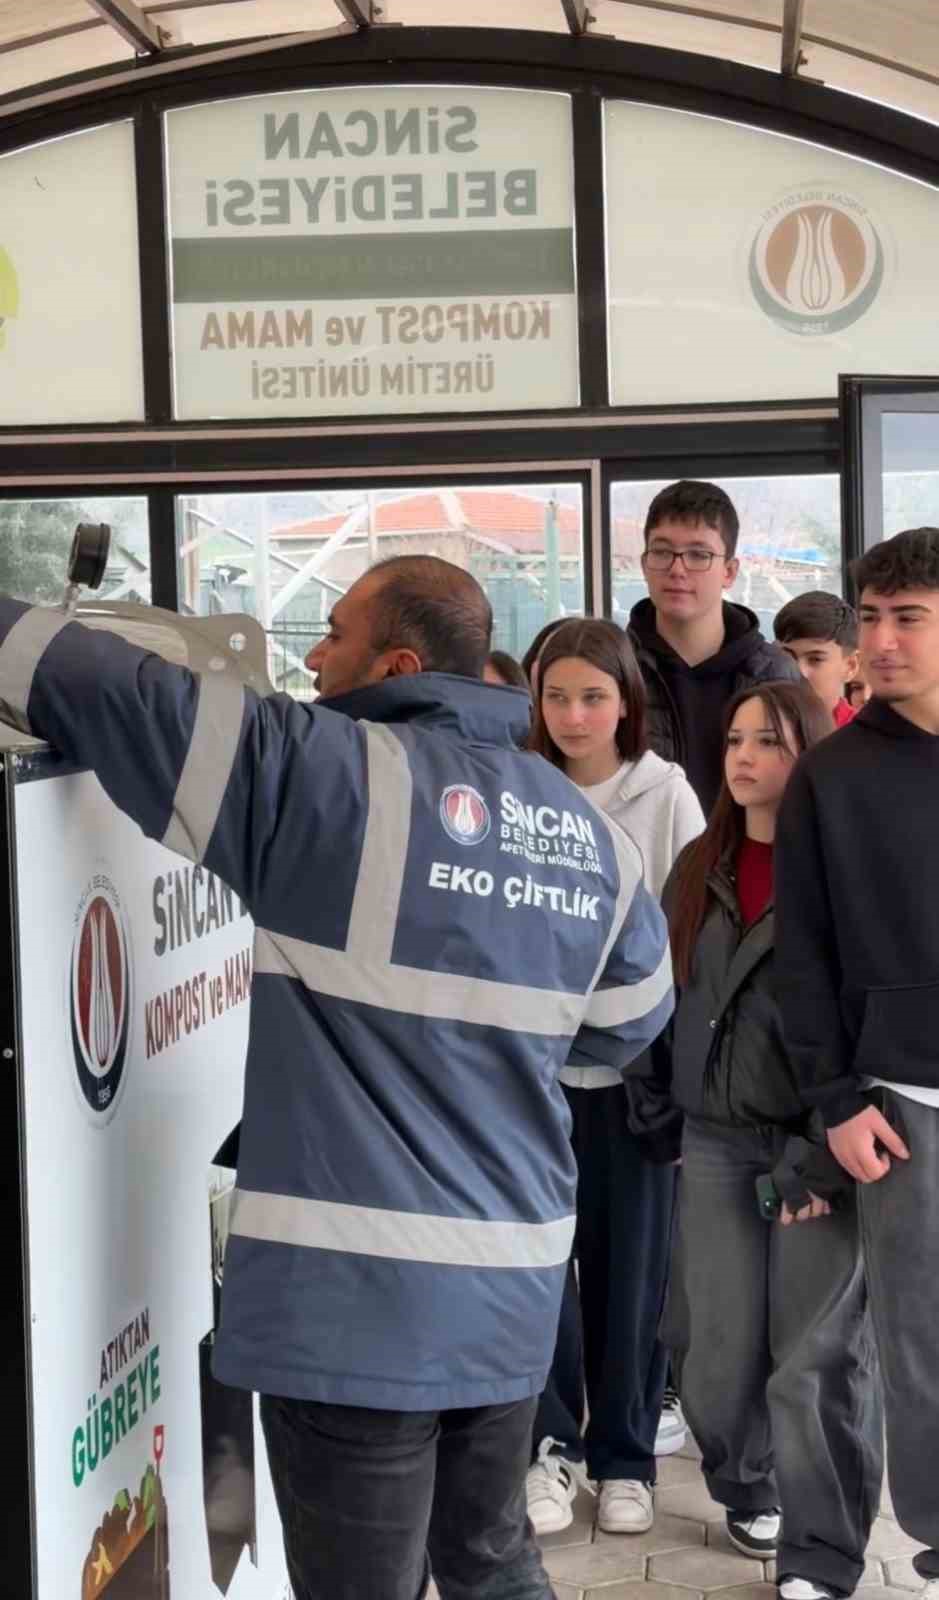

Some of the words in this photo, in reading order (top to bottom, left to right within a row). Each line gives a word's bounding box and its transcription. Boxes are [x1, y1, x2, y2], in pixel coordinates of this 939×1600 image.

[429, 861, 494, 896] EKO
[503, 873, 601, 921] ÇİFTLİK
[144, 971, 207, 1059] KOMPOST
[209, 975, 223, 1020] ve
[225, 947, 251, 1010] MAM
[98, 1307, 151, 1390] ATIKTAN
[71, 1344, 162, 1489] GÜBREYE
